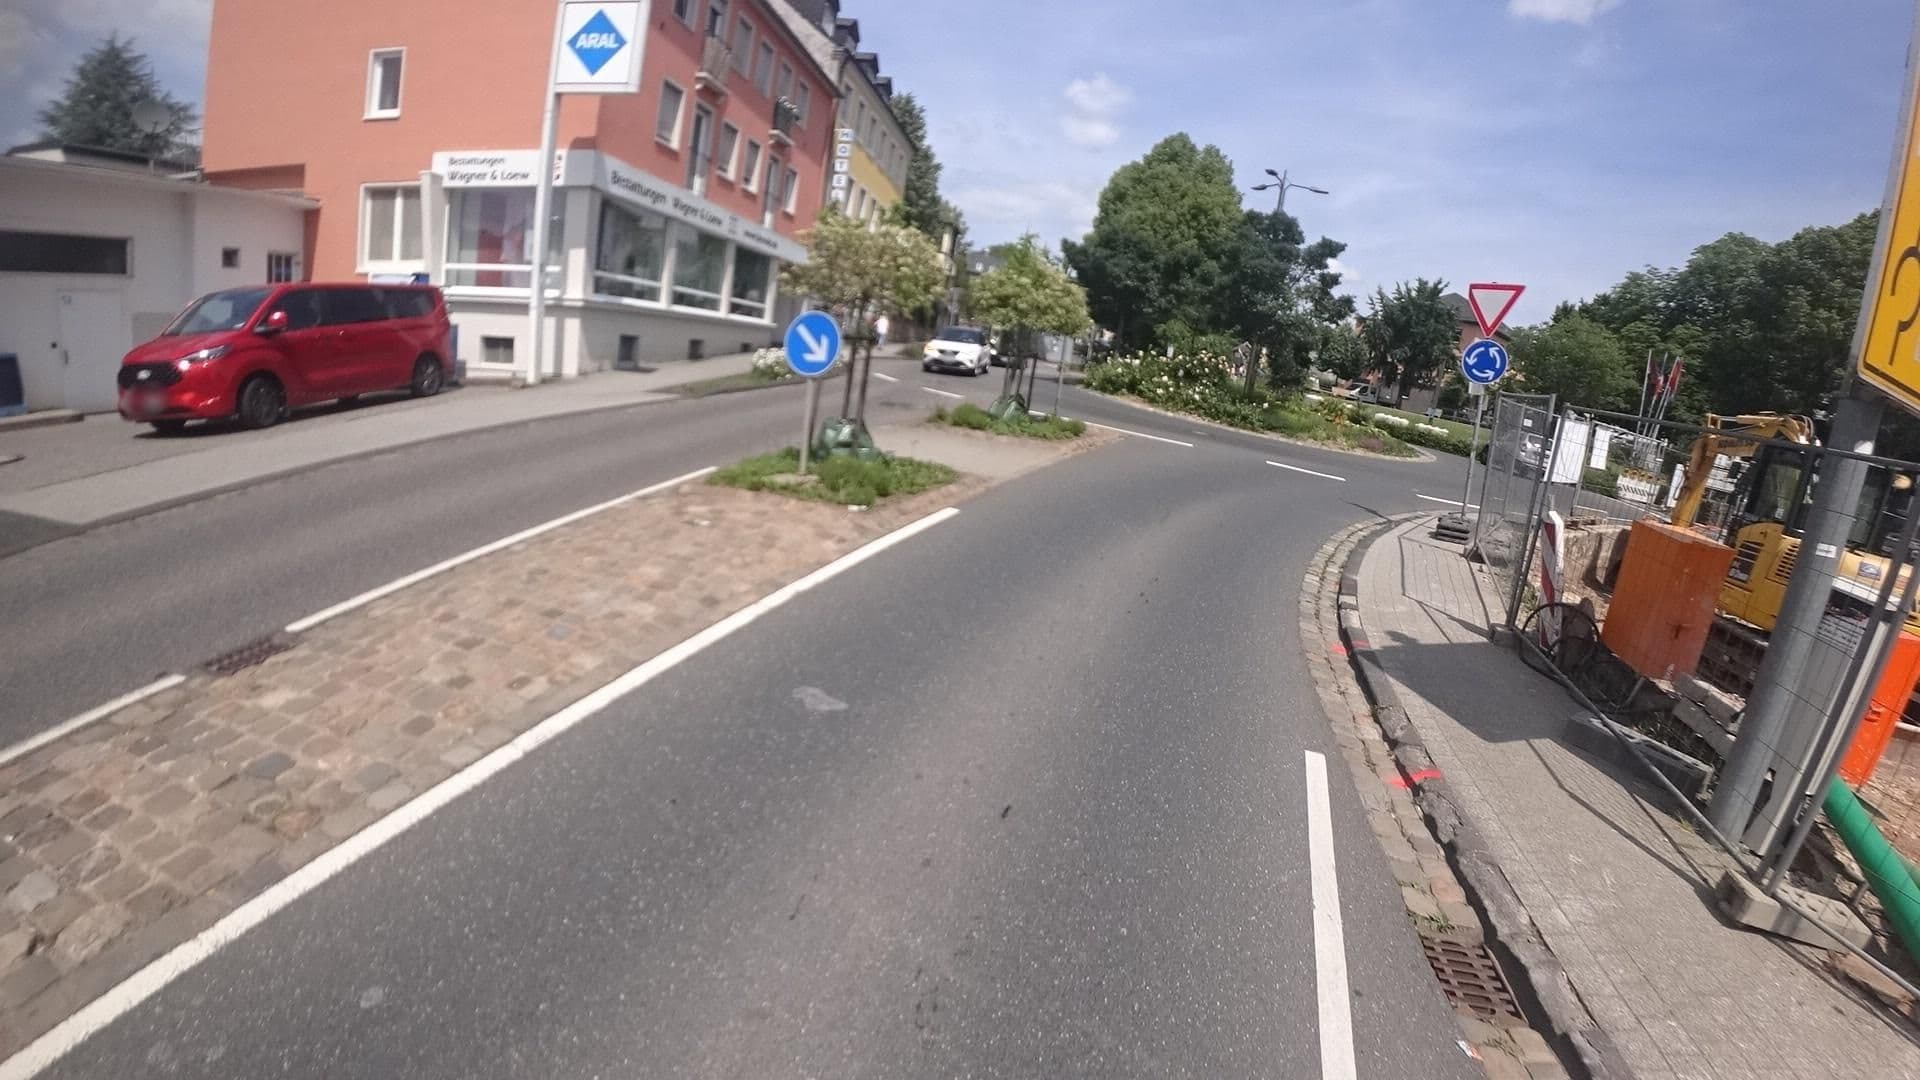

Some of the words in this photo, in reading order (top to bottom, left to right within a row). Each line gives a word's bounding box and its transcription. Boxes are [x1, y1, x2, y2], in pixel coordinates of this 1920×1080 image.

[575, 32, 620, 49] ARAL
[448, 157, 505, 167] Bestattungen
[448, 171, 488, 183] Wagner
[490, 170, 498, 181] &
[611, 170, 667, 205] Bestattungen
[672, 197, 700, 217] Wagner
